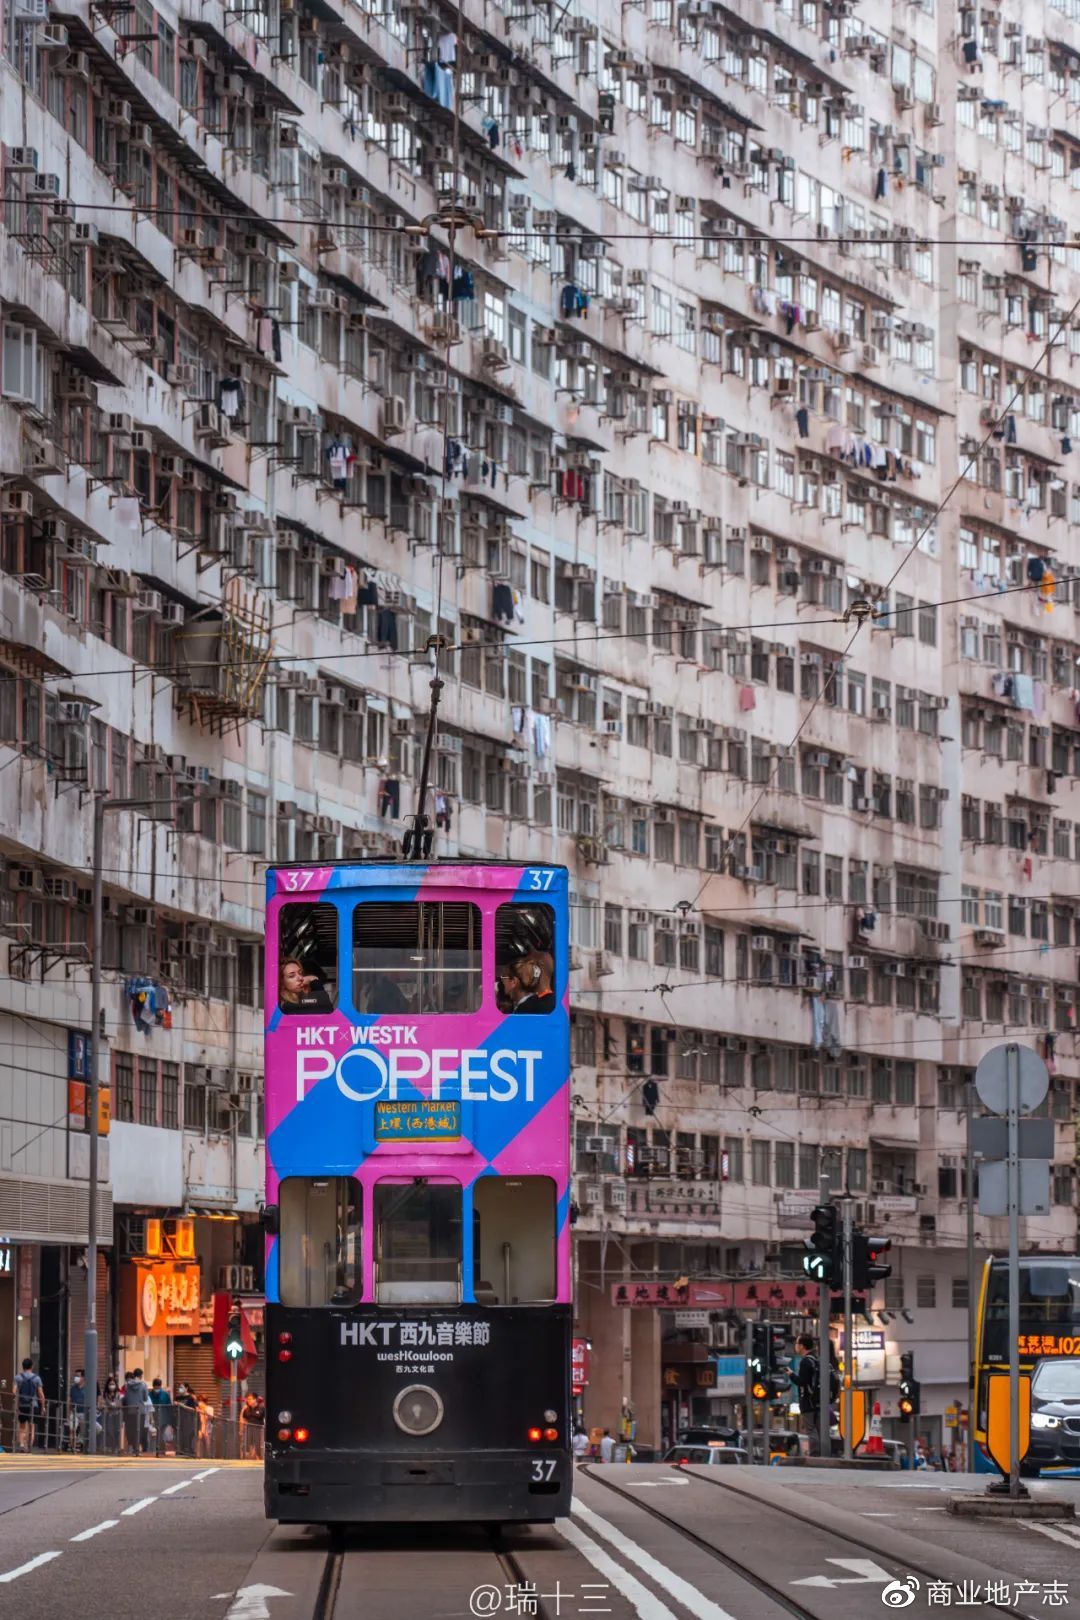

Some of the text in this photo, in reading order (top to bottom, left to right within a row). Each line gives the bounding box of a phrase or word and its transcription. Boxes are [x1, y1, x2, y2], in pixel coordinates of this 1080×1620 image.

[285, 871, 314, 892] 37
[529, 870, 554, 891] 37
[296, 1026, 338, 1045] HKT
[350, 1026, 418, 1045] WESTK
[296, 1048, 543, 1102] POPFEST
[377, 1101, 457, 1114] Western Market
[340, 1321, 491, 1347] HKT 西九音樂節
[395, 1364, 435, 1374] 西九文化區
[531, 1460, 557, 1482] 37
